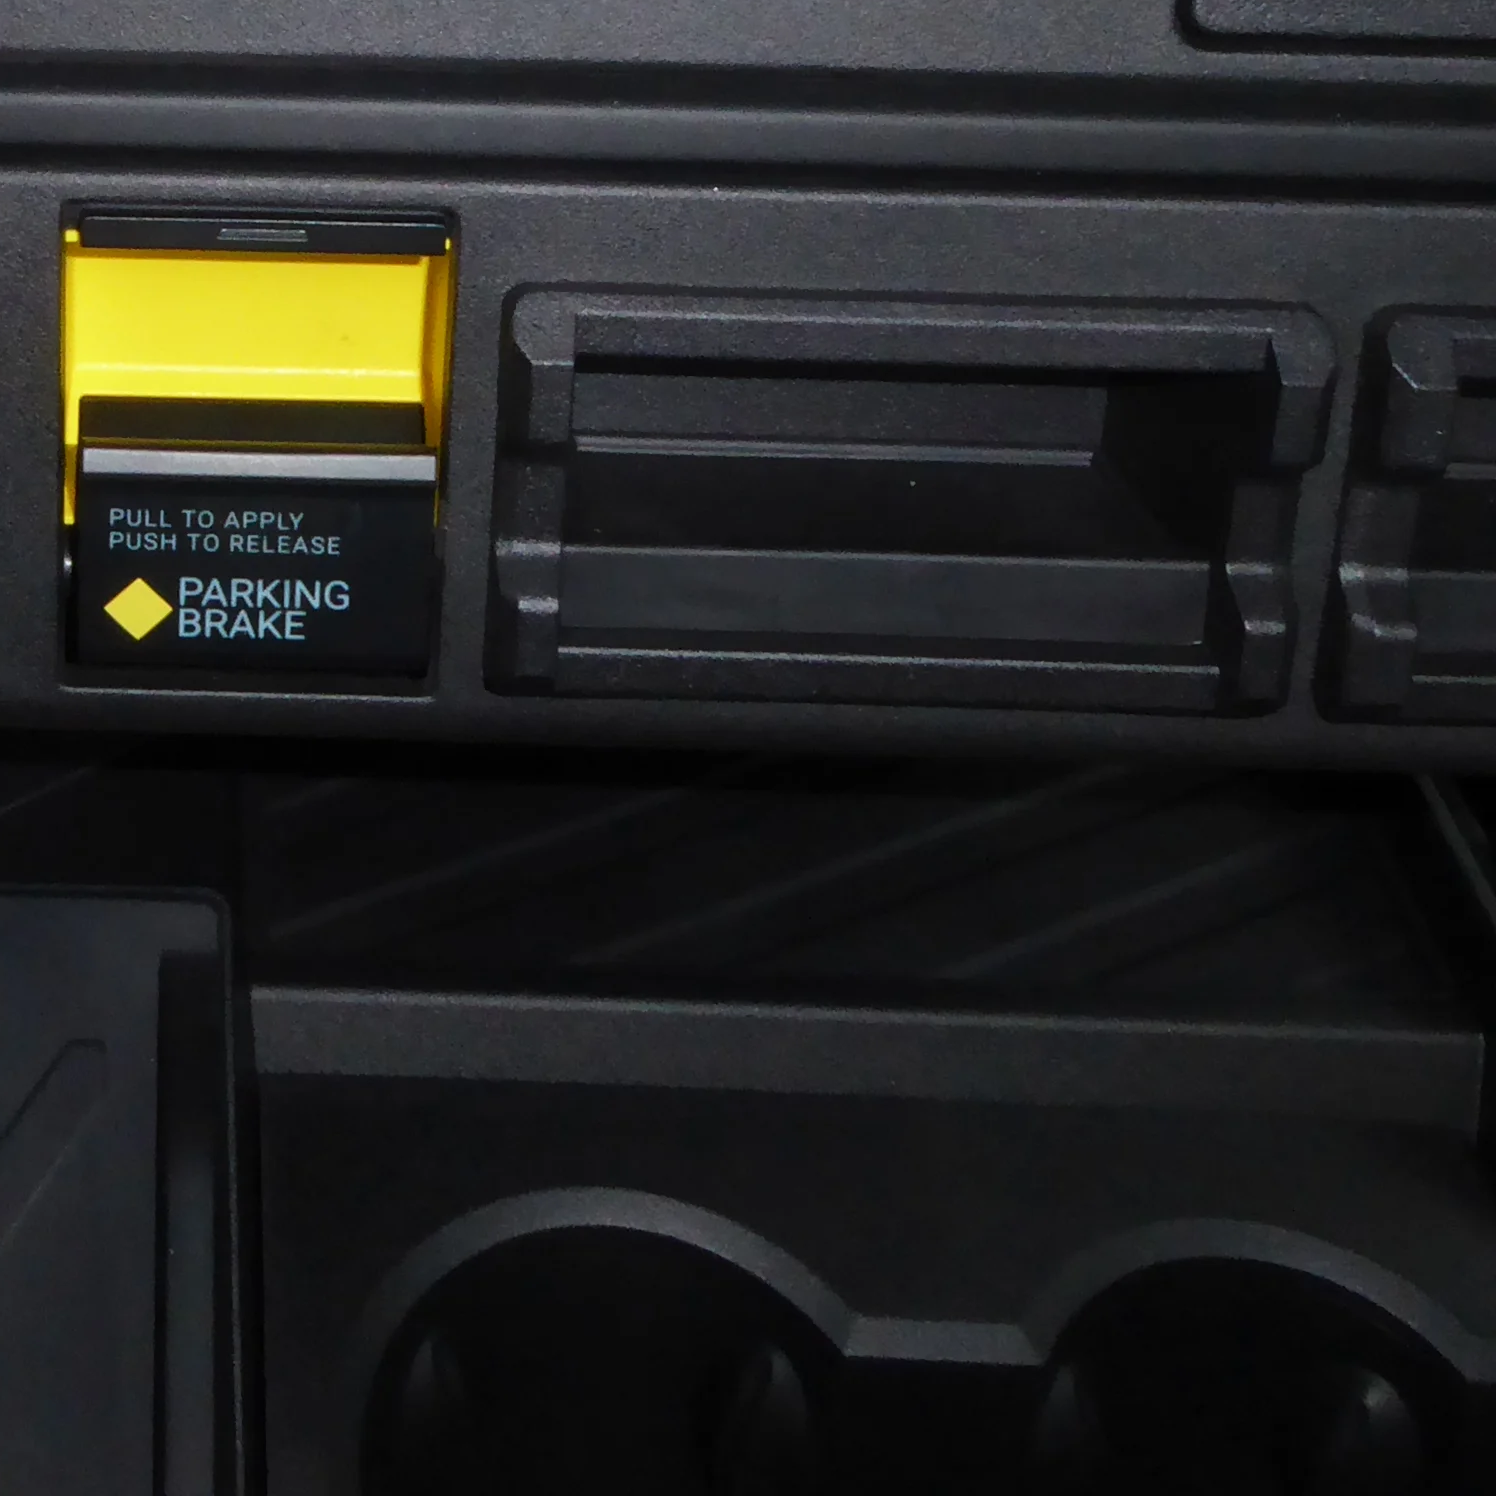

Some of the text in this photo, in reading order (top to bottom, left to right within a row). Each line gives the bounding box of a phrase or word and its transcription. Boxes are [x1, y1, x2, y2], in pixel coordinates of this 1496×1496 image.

[109, 508, 304, 531] PULL TO APPLY
[109, 532, 341, 555] PUSH TO RELEASE
[179, 576, 350, 611] PARKING
[178, 608, 306, 640] BRAKE
